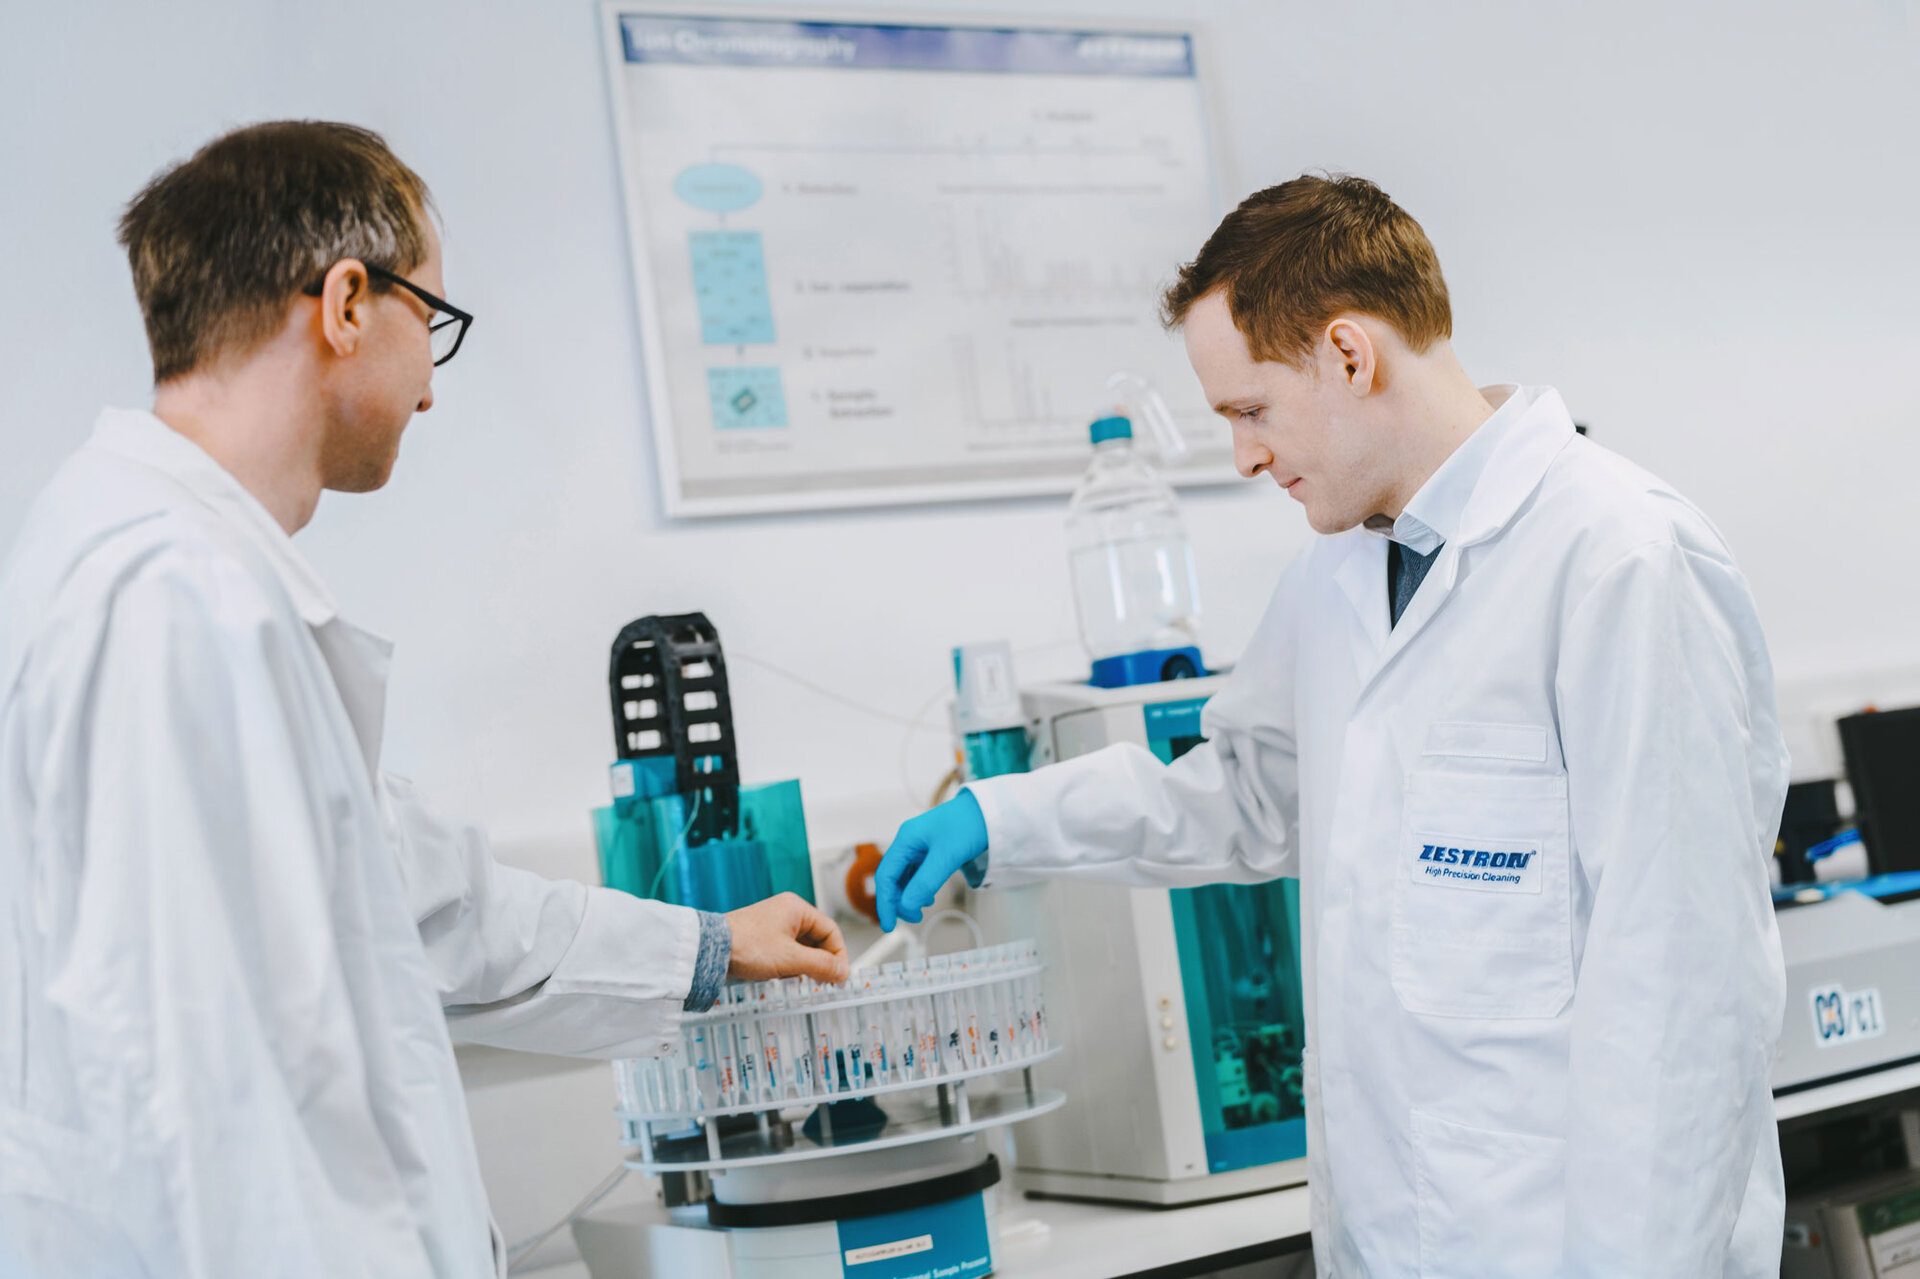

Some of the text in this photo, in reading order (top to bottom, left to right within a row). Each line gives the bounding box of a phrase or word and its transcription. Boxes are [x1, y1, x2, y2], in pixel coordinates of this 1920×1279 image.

[1425, 866, 1521, 884] High Precision Cleaning
